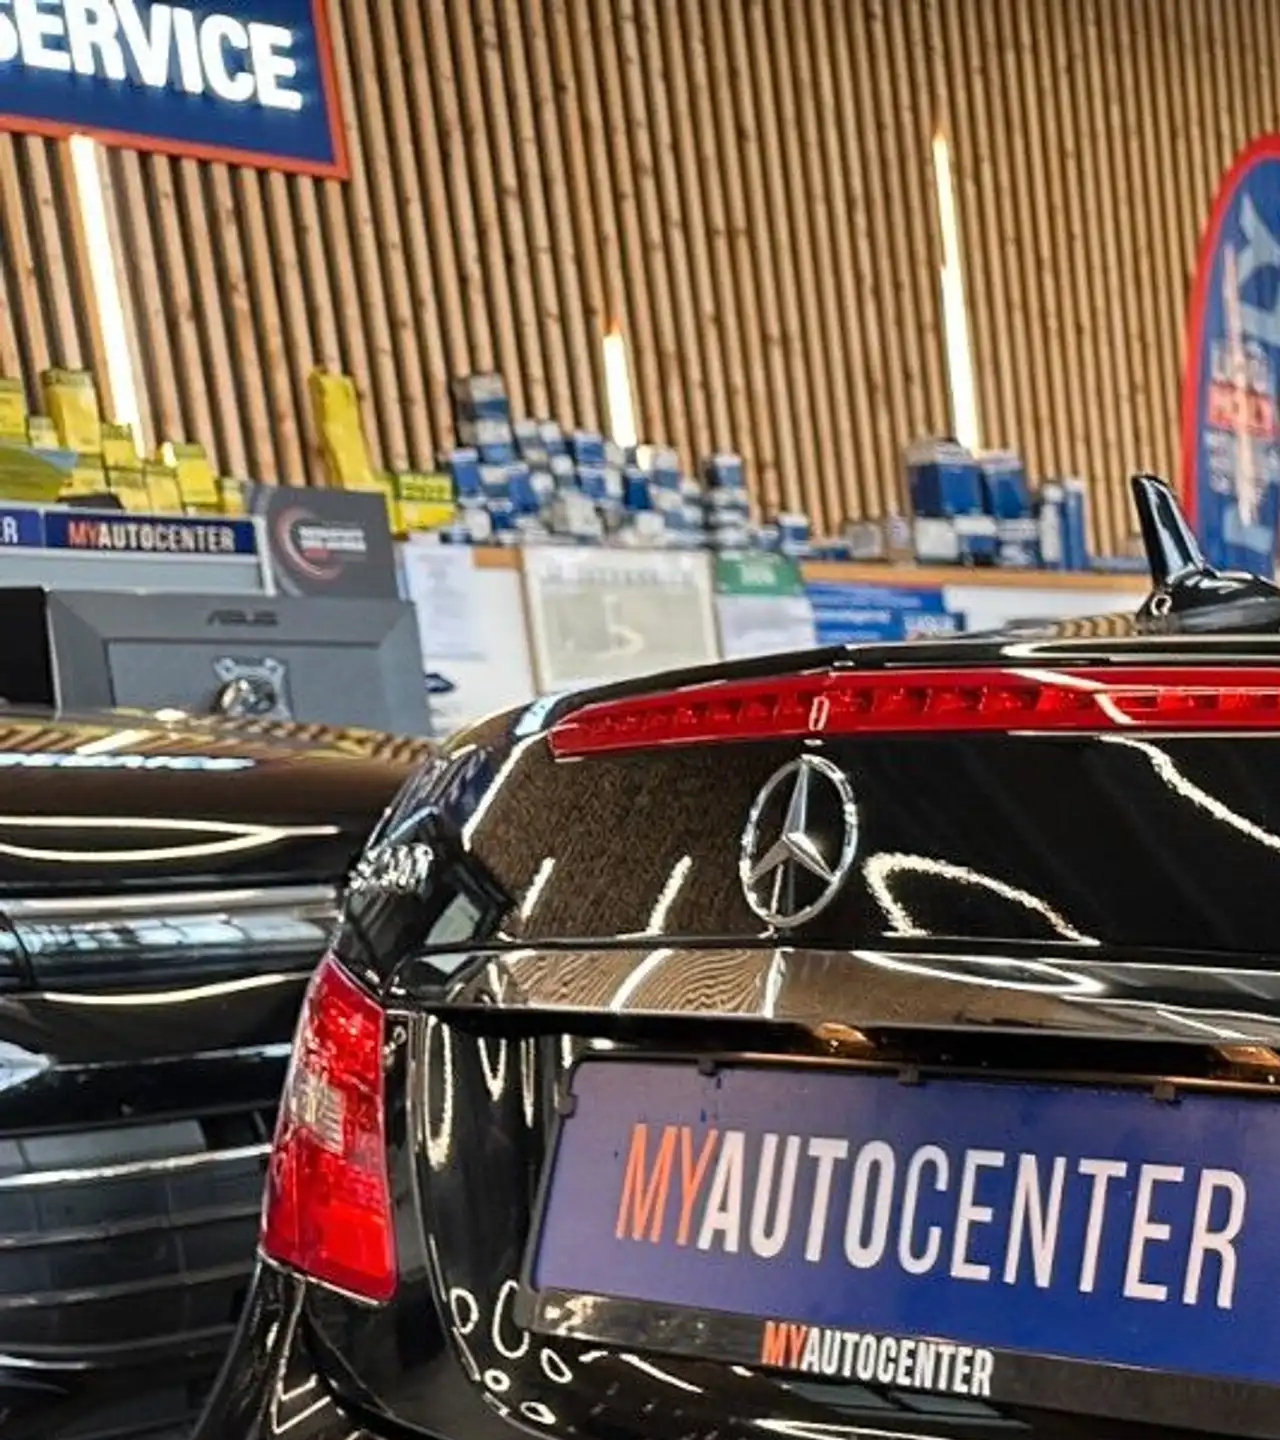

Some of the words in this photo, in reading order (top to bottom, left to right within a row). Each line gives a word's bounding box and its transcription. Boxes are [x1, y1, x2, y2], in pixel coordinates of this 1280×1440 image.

[68, 520, 236, 552] MYAUTOCENTER
[614, 1122, 1247, 1310] MYAUTOCENTER
[761, 1320, 995, 1396] MYAUTOCENTER
